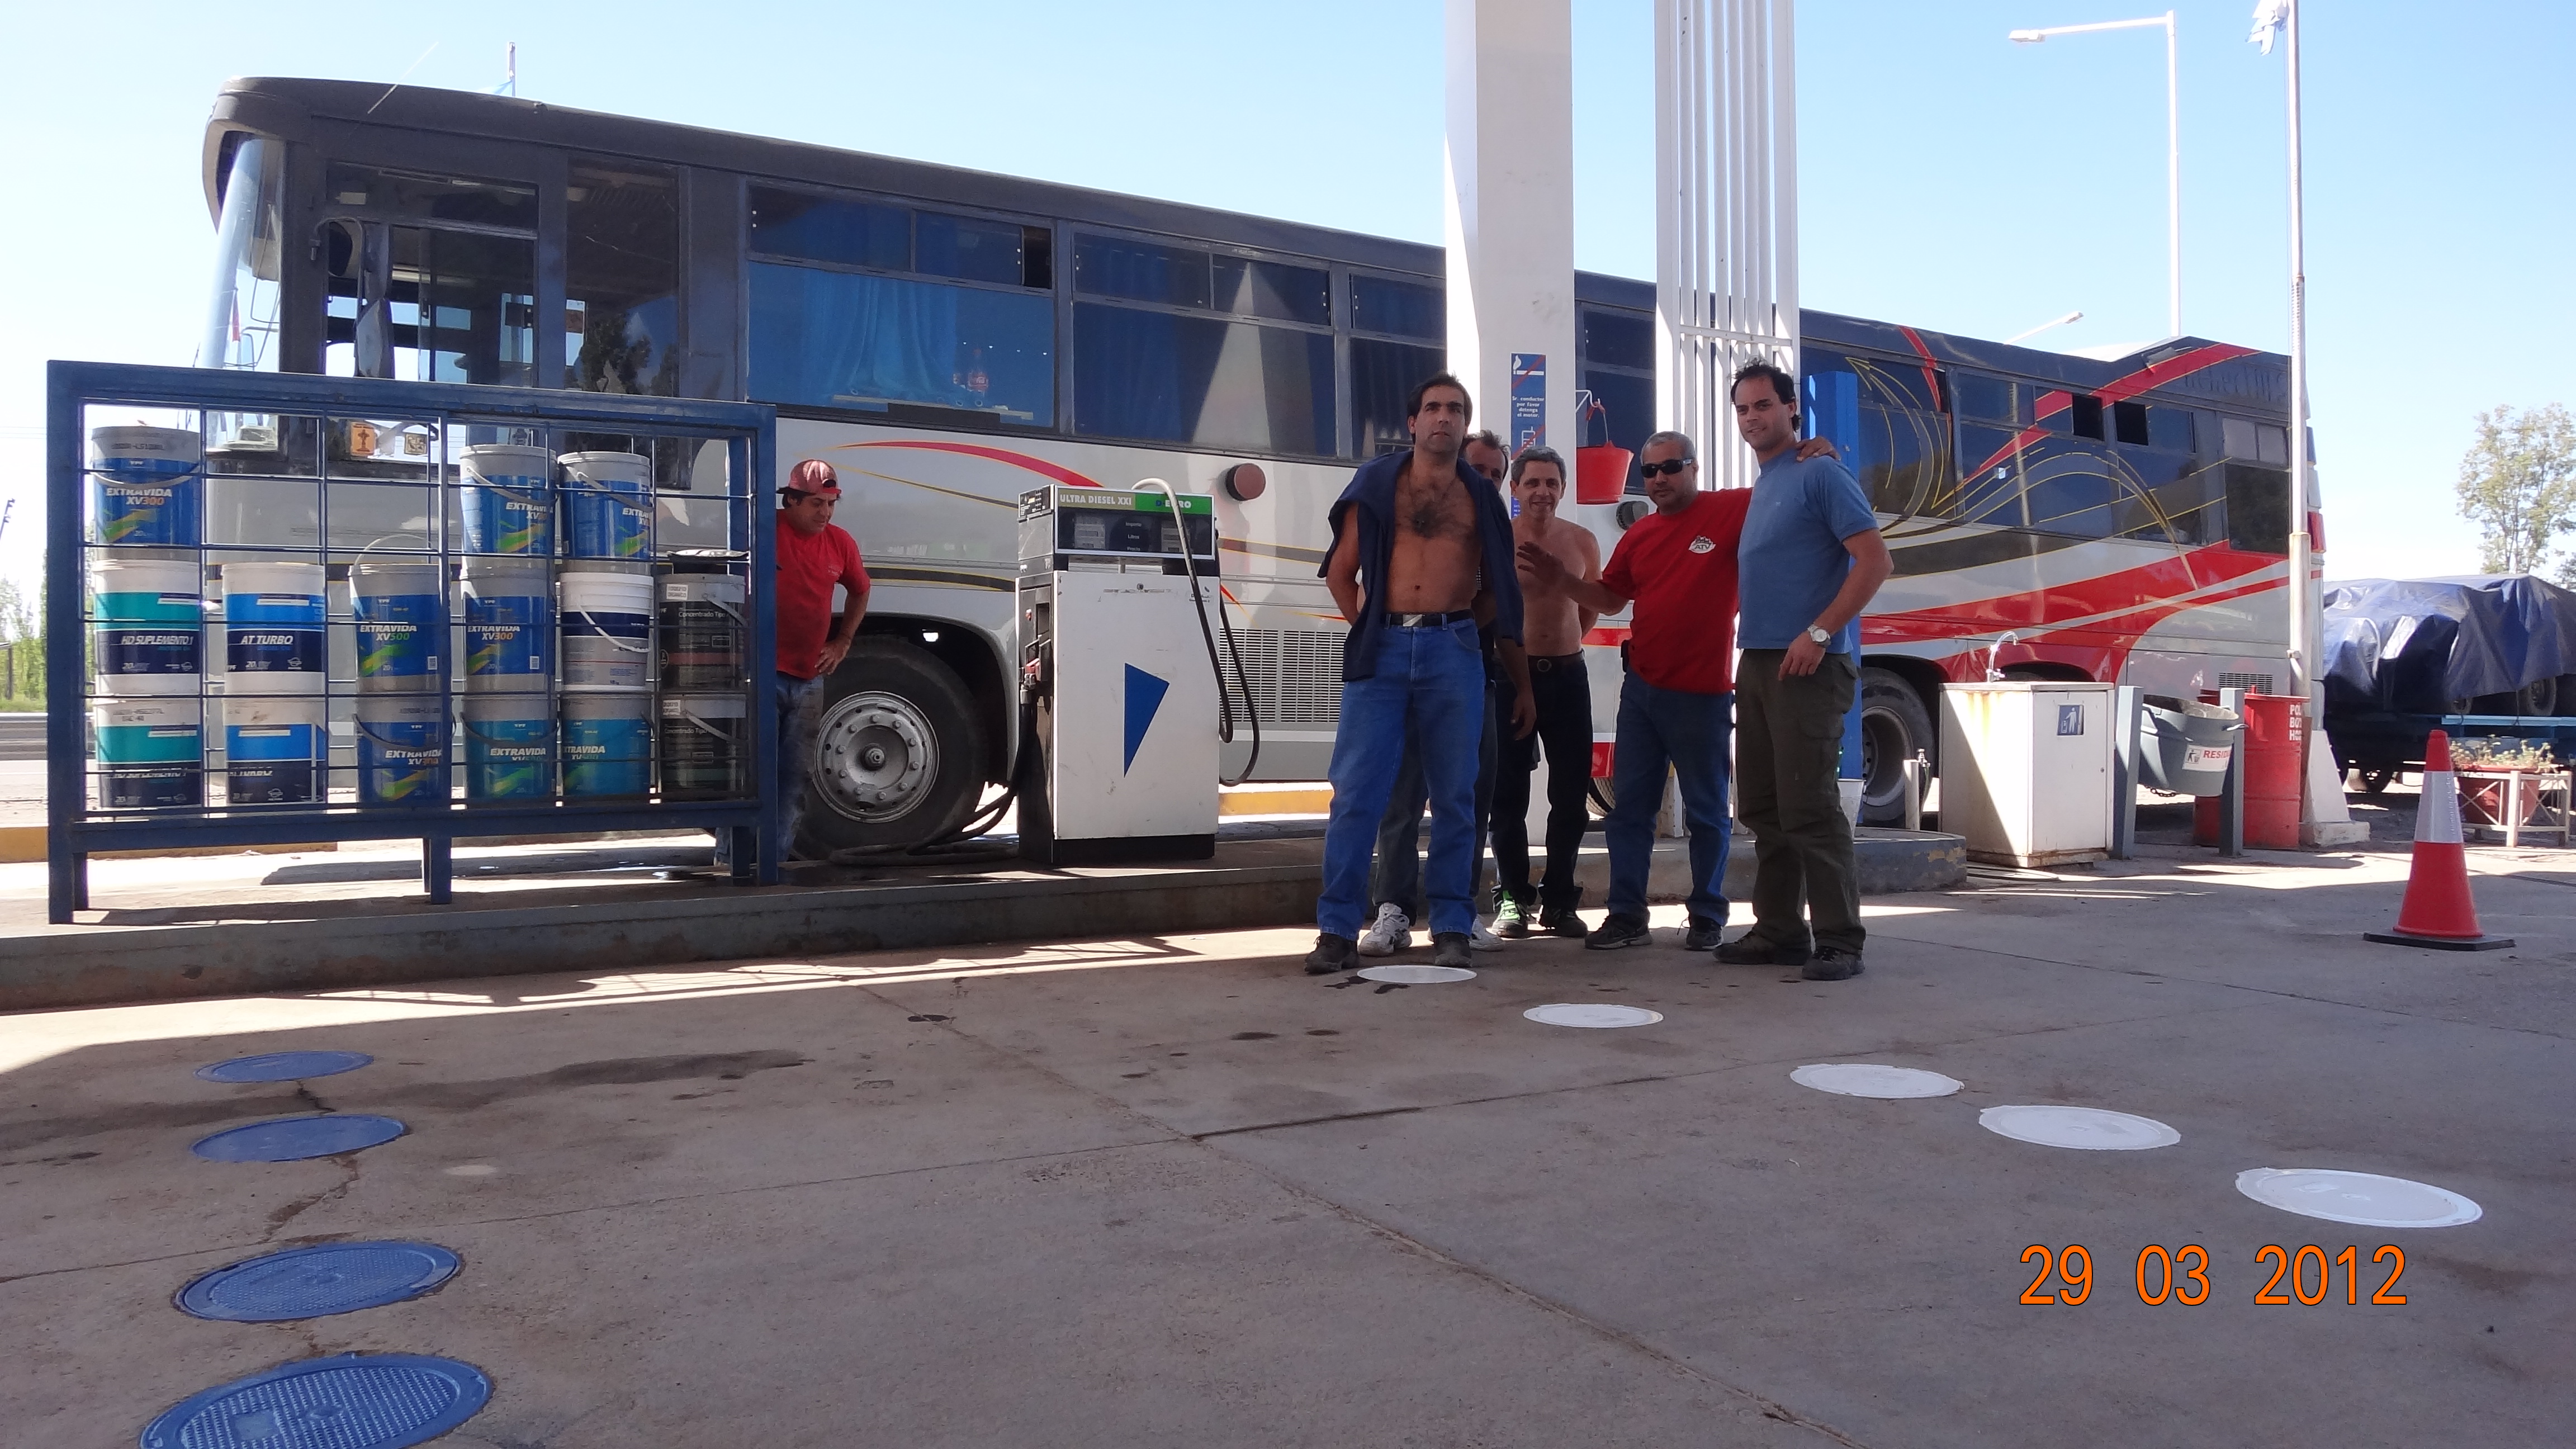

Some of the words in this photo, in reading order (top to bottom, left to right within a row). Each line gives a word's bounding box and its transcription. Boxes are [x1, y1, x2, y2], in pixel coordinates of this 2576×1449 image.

[106, 487, 173, 496] EXTRAVIDA
[126, 496, 165, 505] XV300
[1060, 494, 1086, 504] ULTRA
[1088, 495, 1116, 504] DIESEL
[1117, 496, 1132, 505] XXI
[505, 501, 553, 513] EXTRAVIA
[136, 635, 189, 645] SUPLEMENTO
[240, 635, 255, 645] AT
[257, 635, 293, 645] TURBO
[376, 632, 410, 641] XV500
